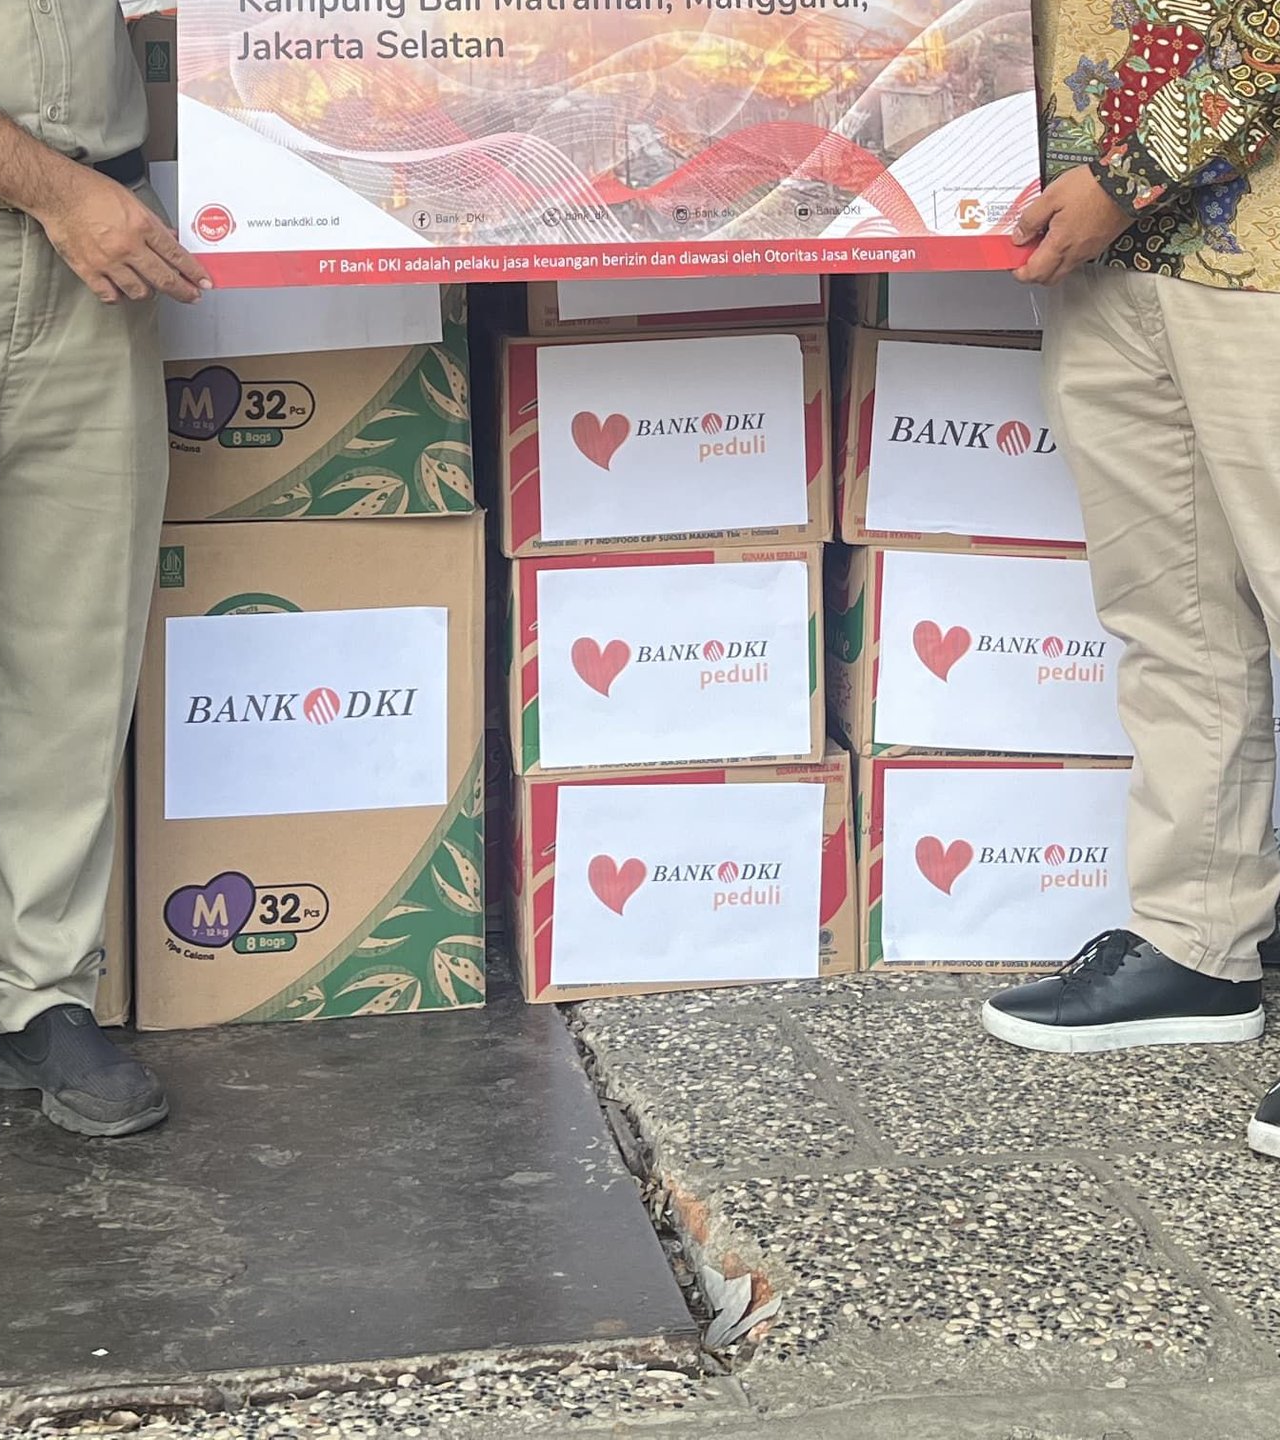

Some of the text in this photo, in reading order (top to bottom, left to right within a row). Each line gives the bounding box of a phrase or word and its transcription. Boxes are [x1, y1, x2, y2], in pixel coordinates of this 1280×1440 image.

[237, 29, 505, 61] Jakarta Selatan
[247, 215, 340, 228] www.bankdki.co.id
[956, 205, 988, 225] LPS
[319, 248, 916, 273] PT Bank DKI adalah pelaku jasa keuangan berizin dan diawasi oleh Otoritas Jasa Keuangan
[178, 386, 215, 420] M
[244, 389, 306, 420] 32 Pcs
[635, 413, 765, 437] BANK DKI
[888, 415, 996, 449] BANK
[232, 431, 272, 444] 8 Bags
[699, 435, 766, 463] peduli
[636, 640, 768, 663] BANK DKI
[975, 635, 1107, 659] BANK DKI
[700, 662, 769, 690] peduli
[1037, 662, 1105, 685] peduli
[184, 688, 419, 724] BANK DKI
[978, 846, 1109, 865] BANK DKI
[651, 862, 783, 882] BANK DKI
[1040, 869, 1108, 893] peduli
[259, 893, 320, 925] 32 Pcs
[713, 885, 781, 911] peduli
[192, 893, 229, 928] M
[246, 936, 286, 950] 8 Bags
